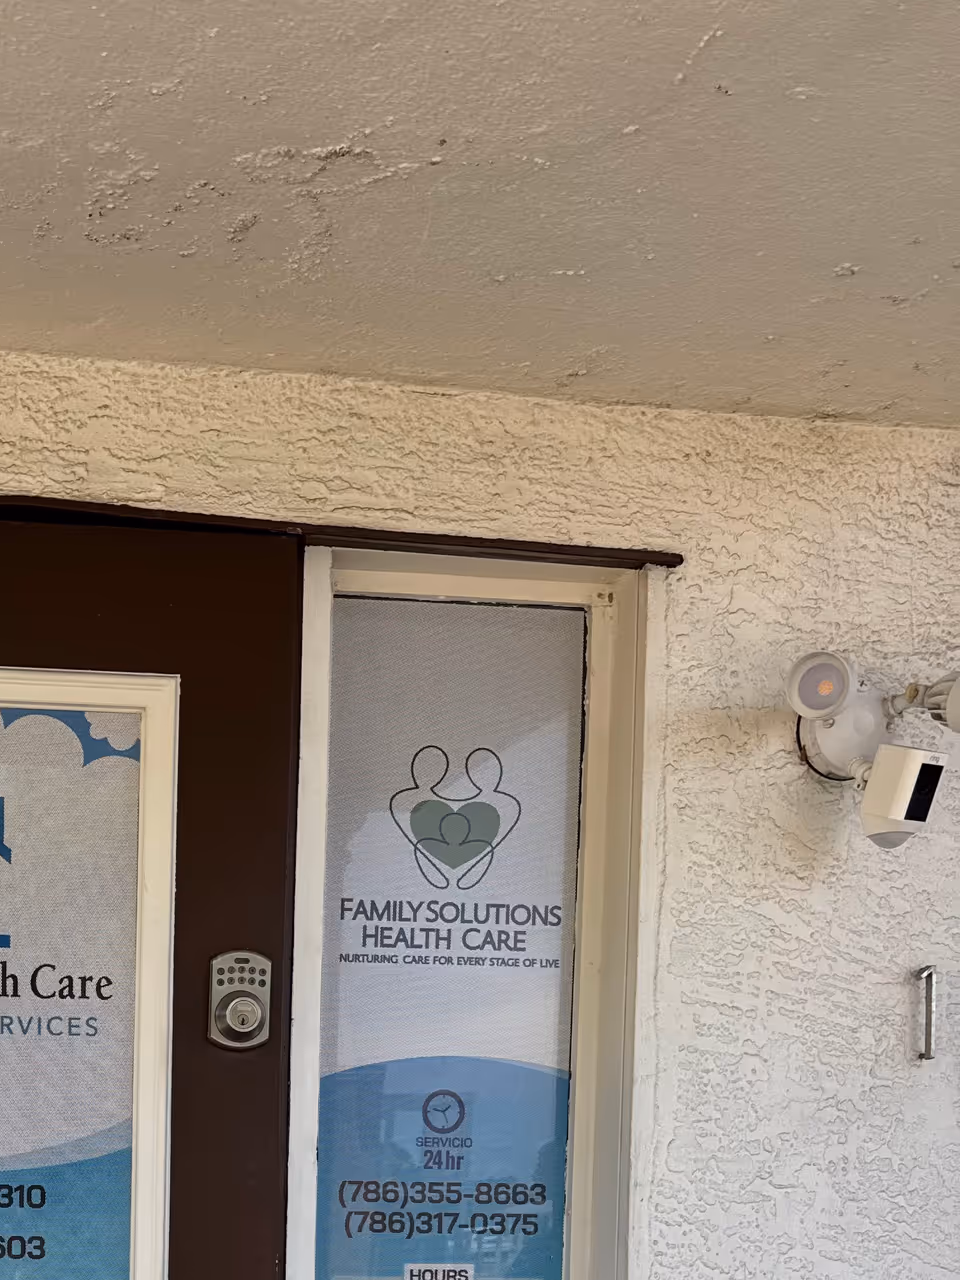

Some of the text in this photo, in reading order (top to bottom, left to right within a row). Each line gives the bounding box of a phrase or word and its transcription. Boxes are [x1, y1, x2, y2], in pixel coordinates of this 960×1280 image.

[362, 925, 527, 951] HEALTH CARE
[340, 953, 560, 968] NURTURING CARE FOR EVERY STAGE OF LIVE
[29, 963, 113, 1000] Care
[415, 1137, 472, 1148] SERVICIO
[338, 1180, 546, 1209] (786)355-8663
[344, 1211, 539, 1239] (786)317-0375
